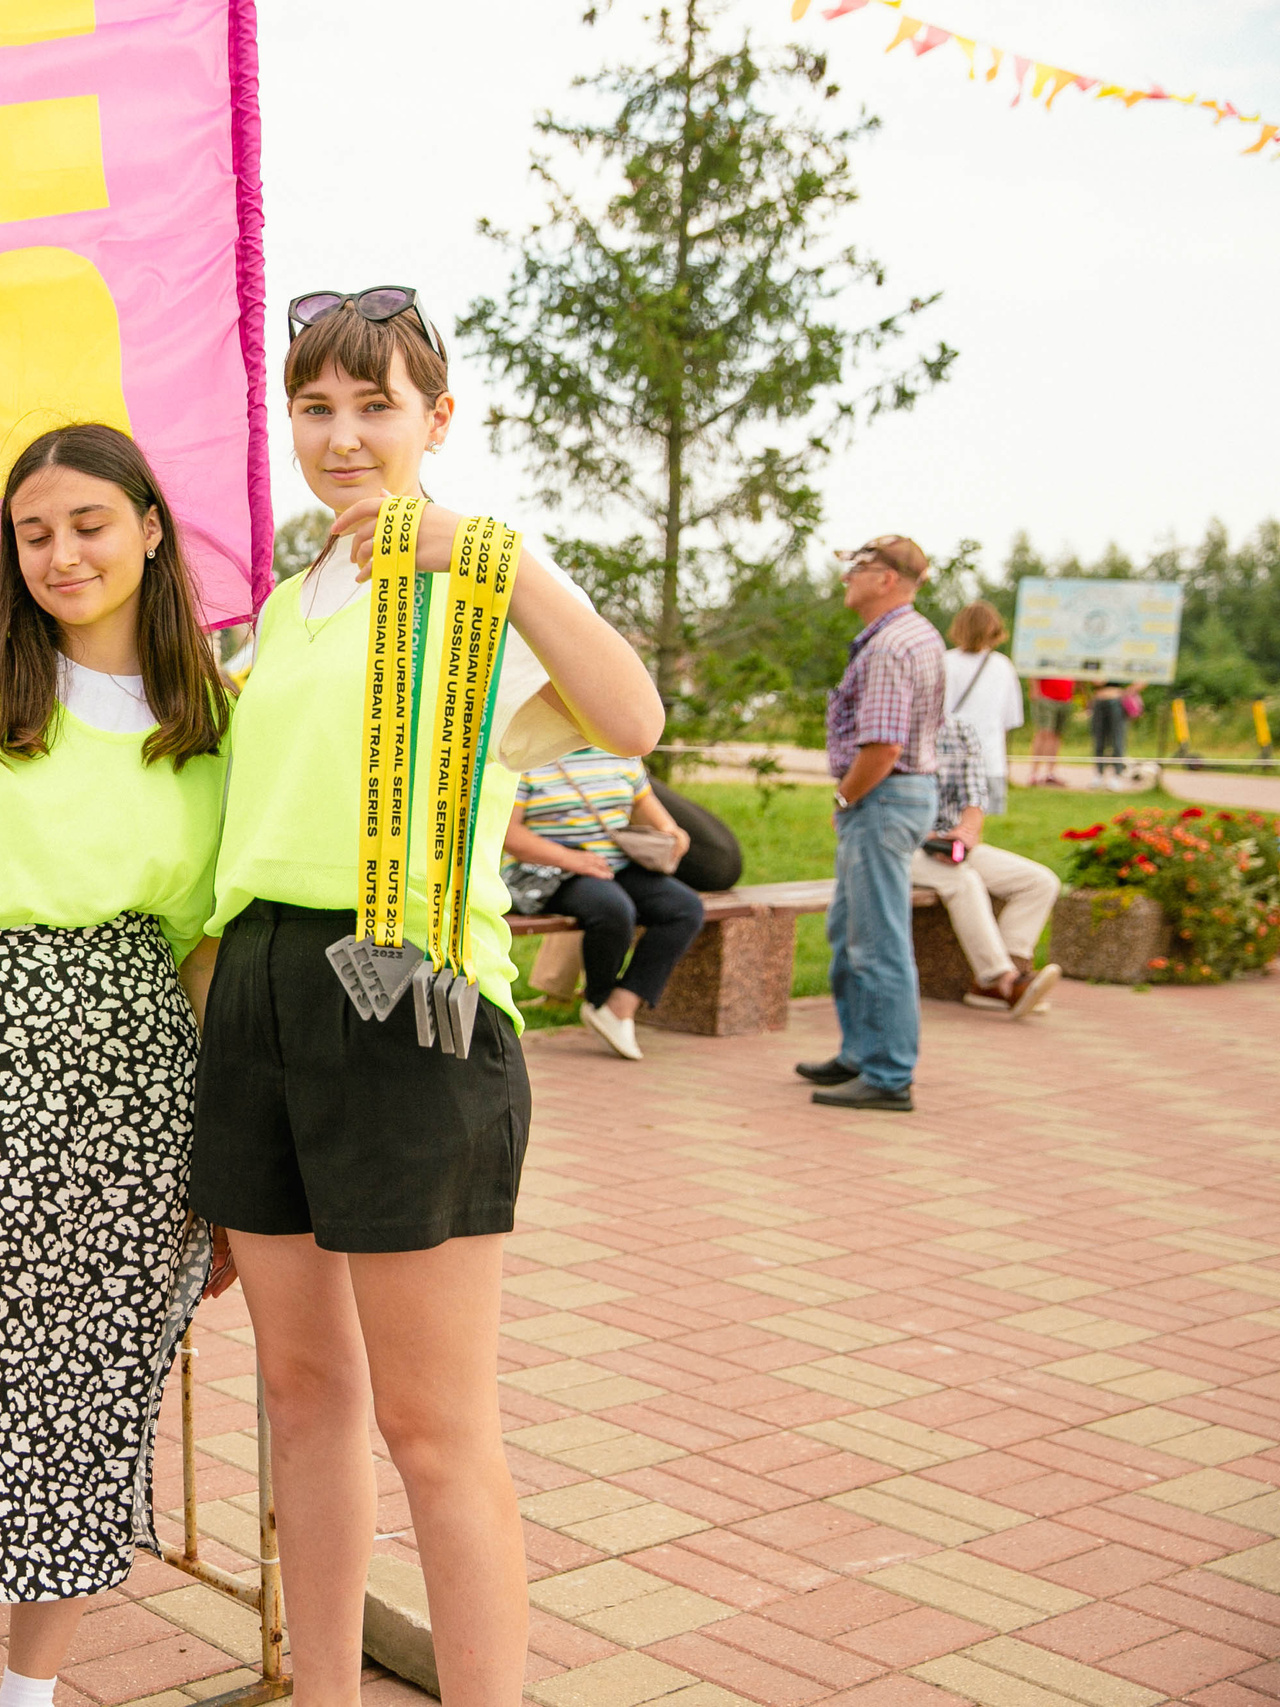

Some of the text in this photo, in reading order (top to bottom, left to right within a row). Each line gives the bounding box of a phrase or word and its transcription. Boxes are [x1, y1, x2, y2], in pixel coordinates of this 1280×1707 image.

[381, 515, 394, 556] 2023
[399, 513, 412, 553] 2023
[459, 536, 474, 577] 2023
[476, 543, 490, 584] 2023
[495, 553, 510, 594] 2023
[375, 578, 389, 654] RUSSIAN
[397, 576, 408, 652] RUSSIAN
[412, 571, 426, 639] ЯРОСЛ
[449, 600, 467, 676] RUSSIAN
[466, 607, 483, 683] RUSSIAN
[371, 659, 384, 720] URBAN
[395, 657, 406, 718] URBAN
[442, 681, 458, 742] URBAN
[462, 688, 476, 748] URBAN
[369, 724, 381, 773] TRAIL
[393, 722, 404, 771] TRAIL
[438, 747, 452, 796] TRAIL
[459, 753, 470, 803] TRAIL
[367, 777, 379, 837] SERIES
[391, 776, 402, 836] SERIES
[434, 800, 447, 860] SERIES
[456, 807, 467, 868] SERIES
[366, 860, 377, 905] RUTS
[387, 860, 399, 905] RUTS
[433, 883, 442, 928] RUTS
[364, 909, 376, 939] 202
[384, 909, 396, 948] 2023
[452, 889, 461, 935] RUTS
